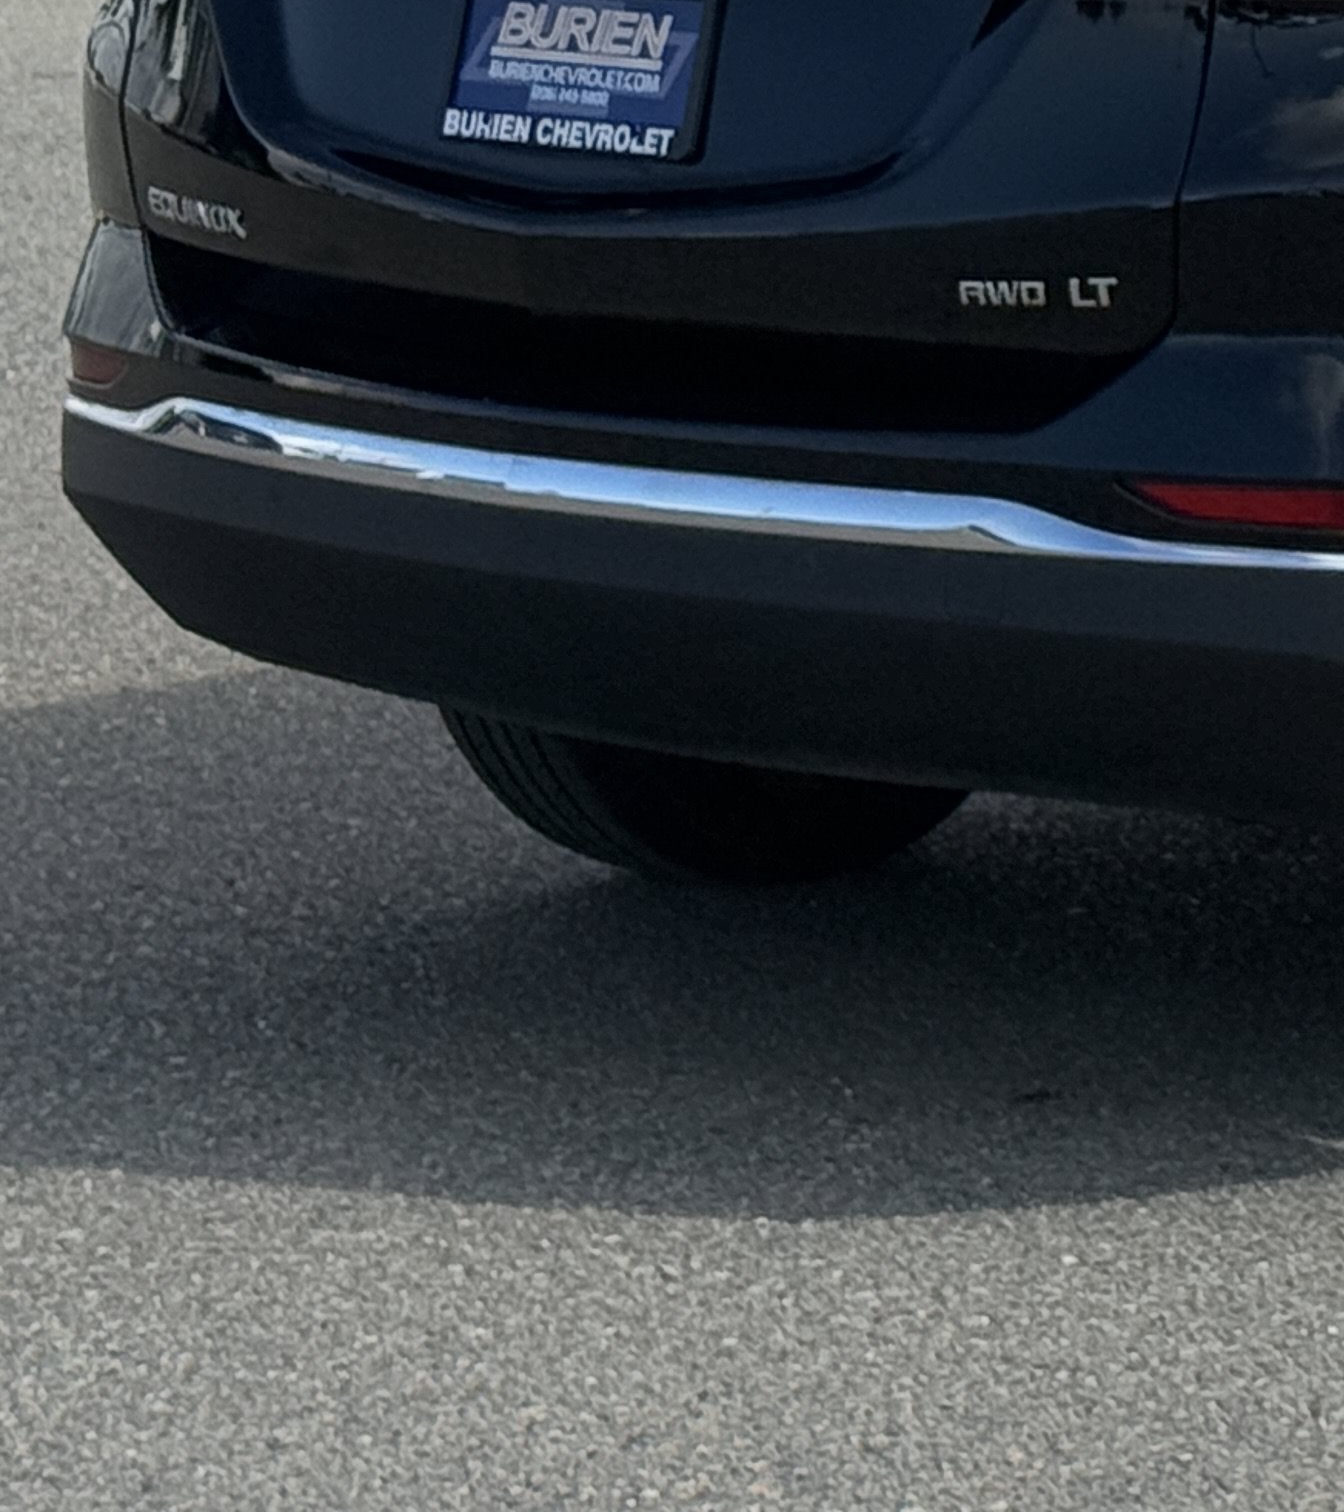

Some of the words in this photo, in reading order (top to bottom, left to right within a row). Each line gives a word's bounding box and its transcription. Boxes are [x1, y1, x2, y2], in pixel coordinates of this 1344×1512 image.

[495, 0, 674, 59] BURIEN
[958, 280, 1047, 308] AWD
[1068, 276, 1119, 309] LT
